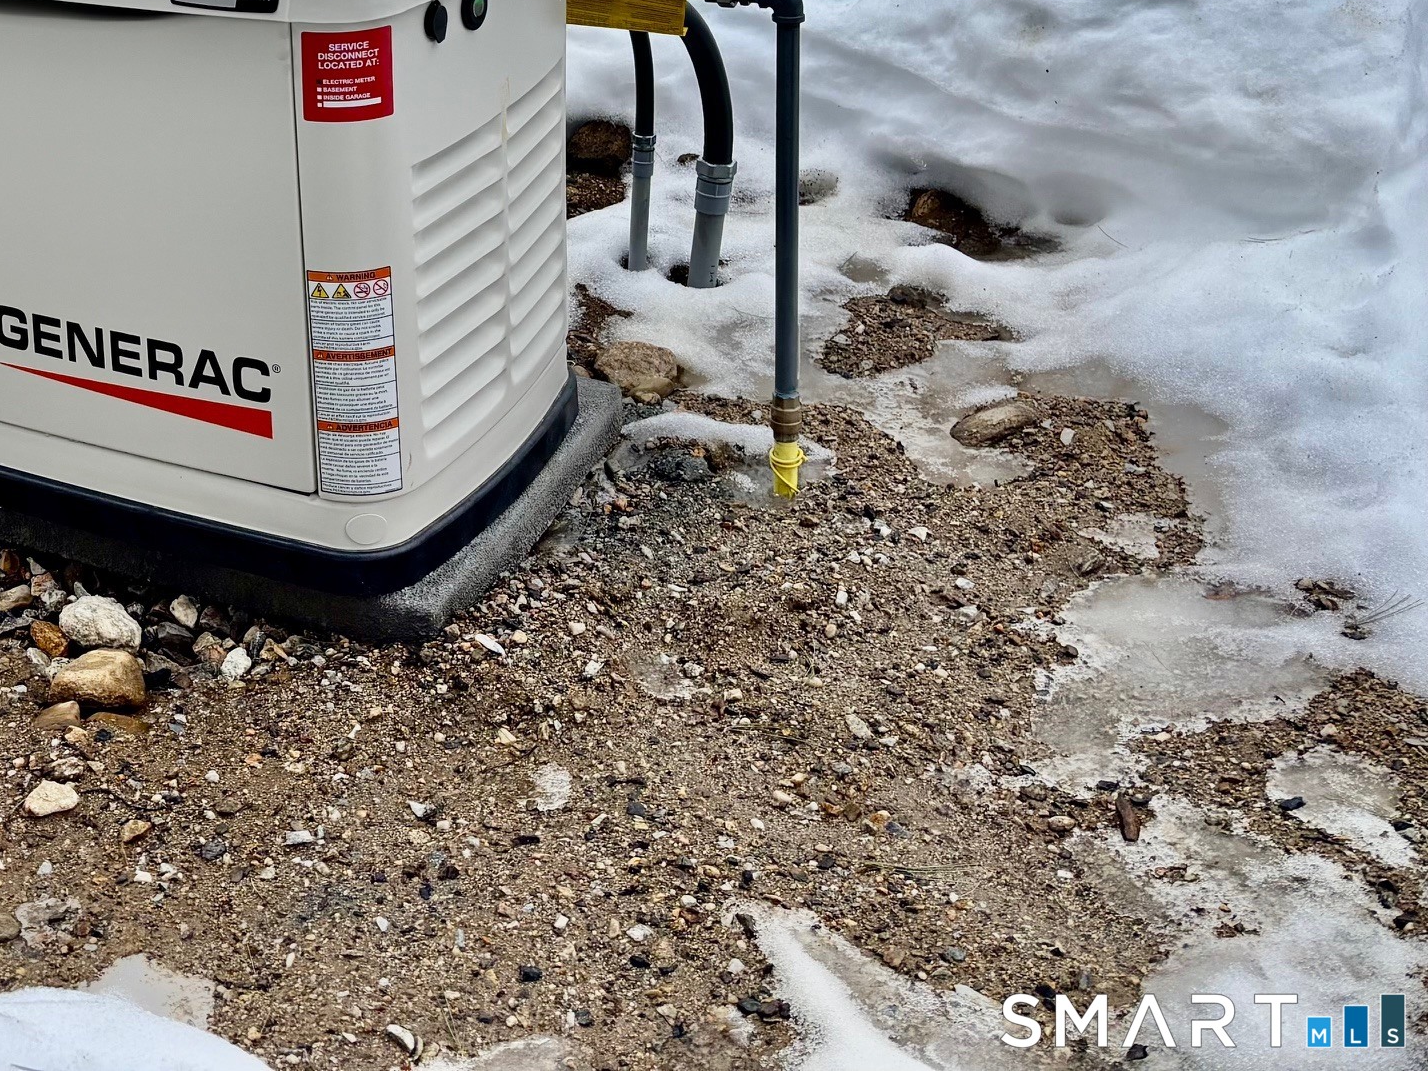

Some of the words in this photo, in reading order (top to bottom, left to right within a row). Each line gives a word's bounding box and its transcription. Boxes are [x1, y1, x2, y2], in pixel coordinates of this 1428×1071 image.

[328, 40, 369, 52] SERVICE
[317, 48, 379, 60] DISCONNECT
[318, 60, 363, 69] LOCATED
[365, 57, 379, 67] AT:
[354, 75, 376, 84] METER
[345, 92, 371, 100] GARAGE
[336, 271, 376, 281] WARNING
[325, 348, 392, 360] AVERTISSEMENT
[336, 420, 393, 432] ADVERTENCIA
